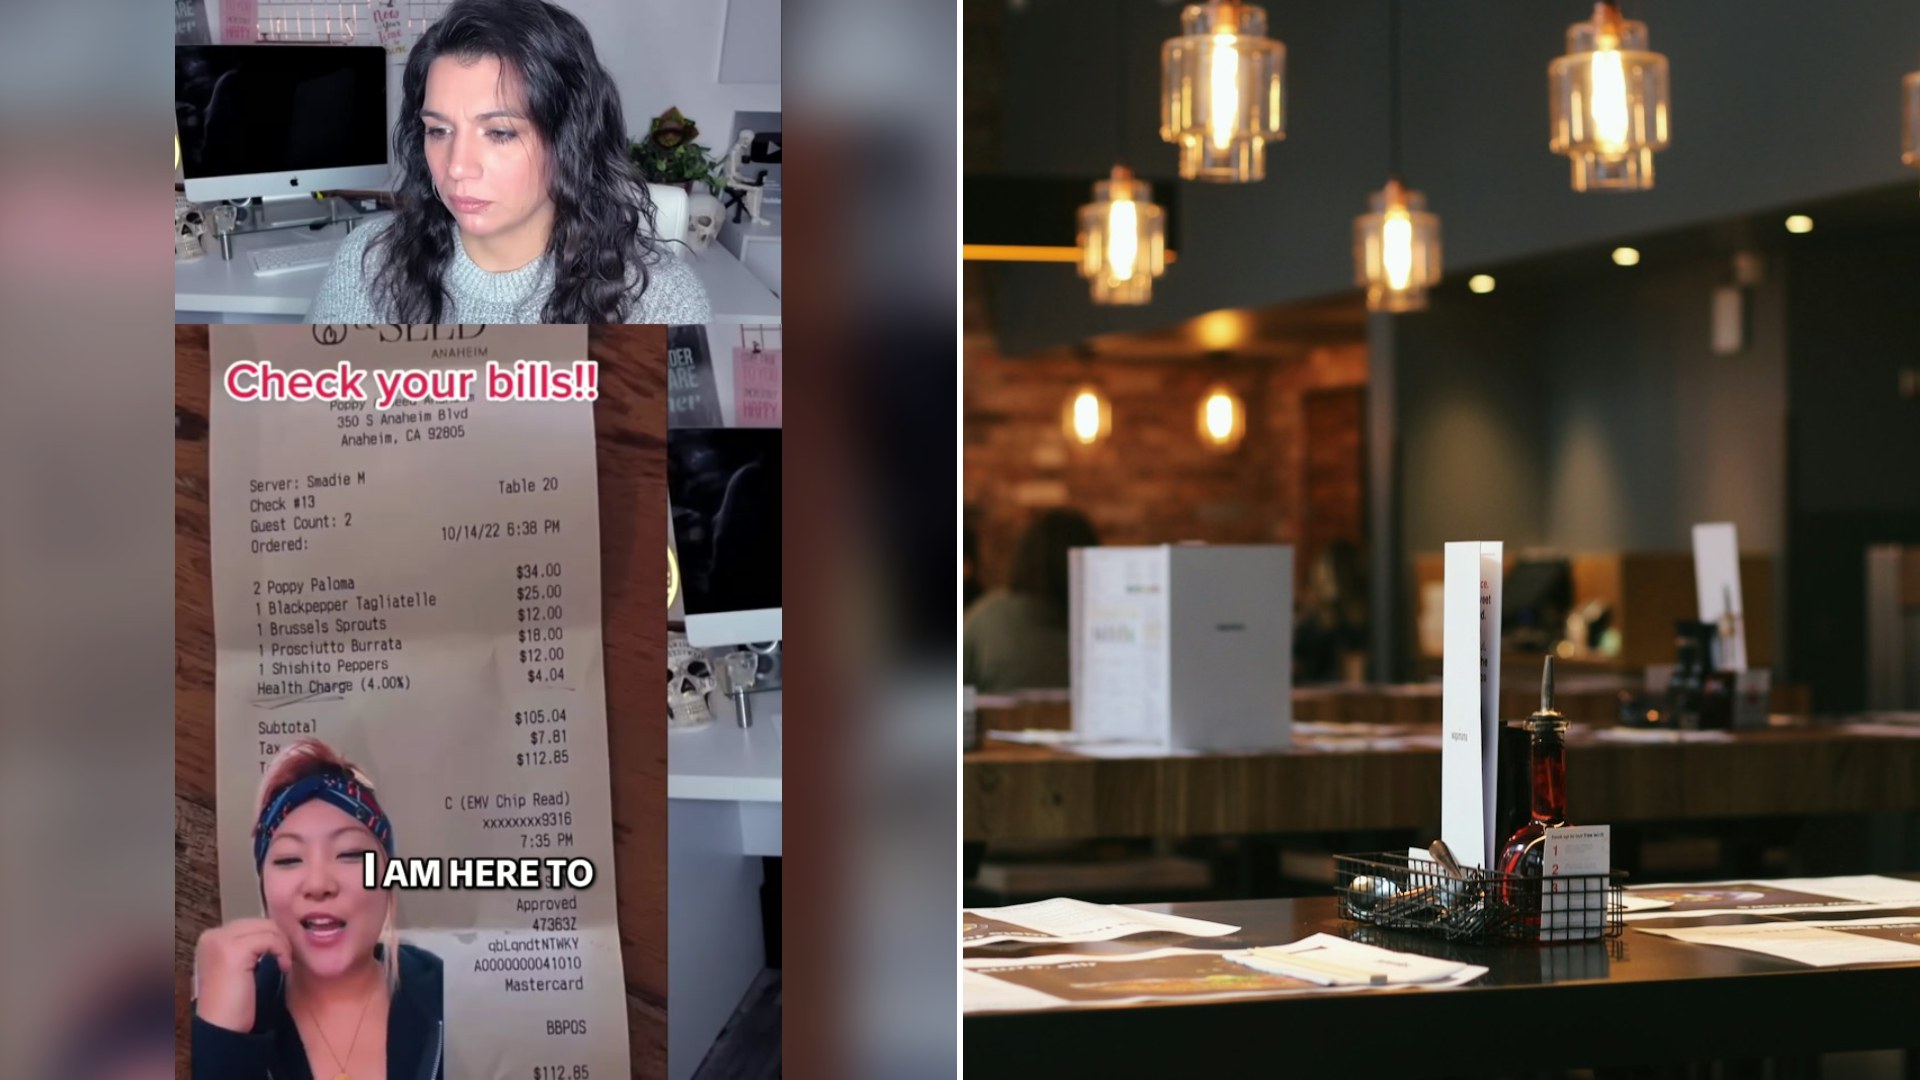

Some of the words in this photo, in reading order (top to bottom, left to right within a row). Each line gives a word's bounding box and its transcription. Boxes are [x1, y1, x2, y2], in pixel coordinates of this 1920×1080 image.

[432, 347, 488, 359] ANAHEIM
[330, 399, 366, 412] Poppy
[337, 415, 359, 428] 350
[366, 414, 374, 427] S
[380, 411, 432, 426] Anaheim
[438, 407, 468, 420] Blvd
[341, 431, 398, 447] Anaheim,
[406, 429, 421, 442] CA
[428, 425, 465, 439] 92805
[249, 478, 300, 494] Server:
[307, 473, 351, 489] Smadie
[357, 472, 366, 486] M
[498, 478, 536, 495] Table
[542, 477, 558, 492] 20
[249, 497, 287, 513] Check
[293, 495, 316, 510] #13
[250, 517, 287, 533] Guest
[293, 514, 337, 531] Count:
[344, 513, 352, 528] 2
[441, 523, 501, 542] 10/14/22
[506, 521, 537, 537] 6:38
[544, 520, 561, 534] PM
[250, 537, 309, 554] Ordered:
[516, 563, 561, 579] $34.00
[253, 581, 261, 595] 2
[267, 578, 304, 596] Poppy
[311, 576, 355, 592] Paloma
[516, 584, 562, 601] $25.00
[255, 602, 261, 615] 1
[268, 599, 349, 617] Blackpepper
[356, 592, 437, 611] Tagliatelle
[518, 606, 562, 623] $12.00
[256, 623, 262, 636] 1
[270, 619, 329, 636] Brussels
[335, 617, 387, 634] Sprouts
[519, 626, 563, 643] $18.00
[258, 644, 264, 657] 1
[271, 640, 345, 657] Prosciutto
[351, 638, 403, 653] Burrata
[519, 647, 564, 664] $12.00
[258, 663, 264, 675] 1
[272, 660, 331, 675] Shishito
[337, 658, 389, 674] Peppers
[527, 668, 565, 683] $4.04
[257, 680, 303, 696] Health
[309, 678, 353, 695] Charge
[360, 675, 411, 692] (4.00%)
[514, 709, 567, 726] $105.04
[258, 719, 316, 735] Subtotal
[530, 730, 567, 746] $7.81
[259, 741, 280, 755] Tax
[516, 751, 569, 767] $112.85
[445, 797, 453, 810] C
[461, 794, 489, 811] (EMV
[496, 793, 526, 810] Chip
[533, 791, 570, 808] Read)
[482, 813, 572, 829] xxxxxxxx9316
[521, 834, 550, 849] 7:35
[558, 833, 574, 847] PM
[1553, 845, 1558, 856] 1
[1552, 864, 1559, 875] 2
[517, 895, 577, 912] Approved
[532, 916, 577, 932] 47363Z
[474, 956, 582, 973] A0000000041010
[505, 977, 584, 992] Mastercard
[546, 1020, 587, 1035] BBPOS
[533, 1065, 589, 1080] $112.85
